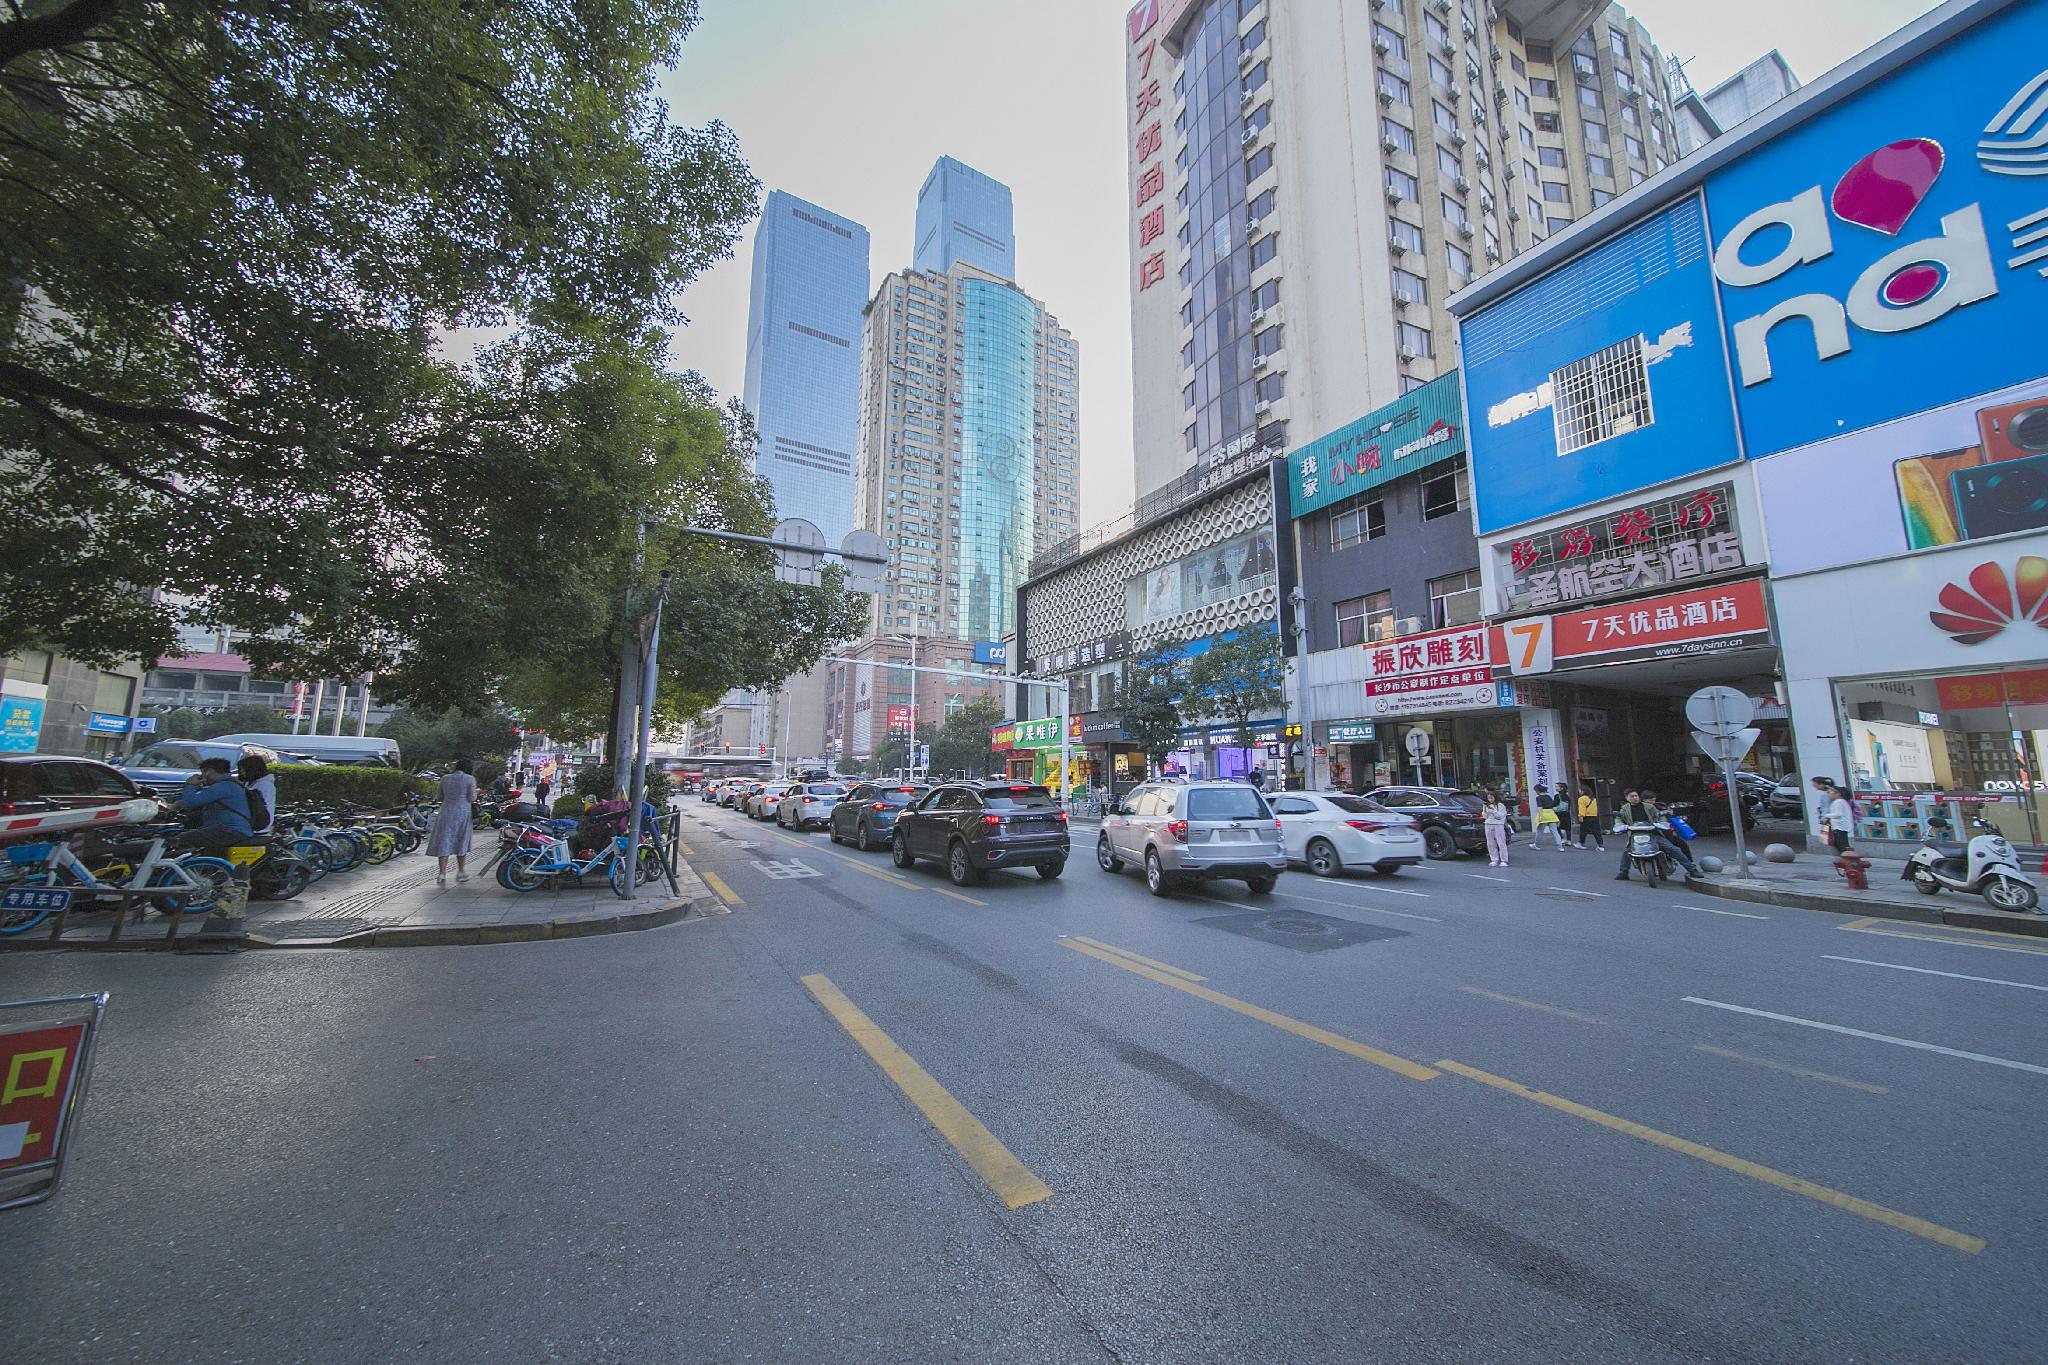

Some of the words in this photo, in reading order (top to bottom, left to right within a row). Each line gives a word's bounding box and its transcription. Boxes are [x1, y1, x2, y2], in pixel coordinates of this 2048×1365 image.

[1136, 39, 1165, 292] 7天优品酒店
[1300, 455, 1319, 499] 我家
[1581, 596, 1737, 642] 7天优品酒店
[1372, 632, 1485, 675] 振欣雕刻
[1511, 622, 1545, 669] 7
[1655, 637, 1743, 657] www.7daysinn.cn
[1025, 722, 1058, 741] 果唯伊
[7, 892, 64, 906] 专用车位
